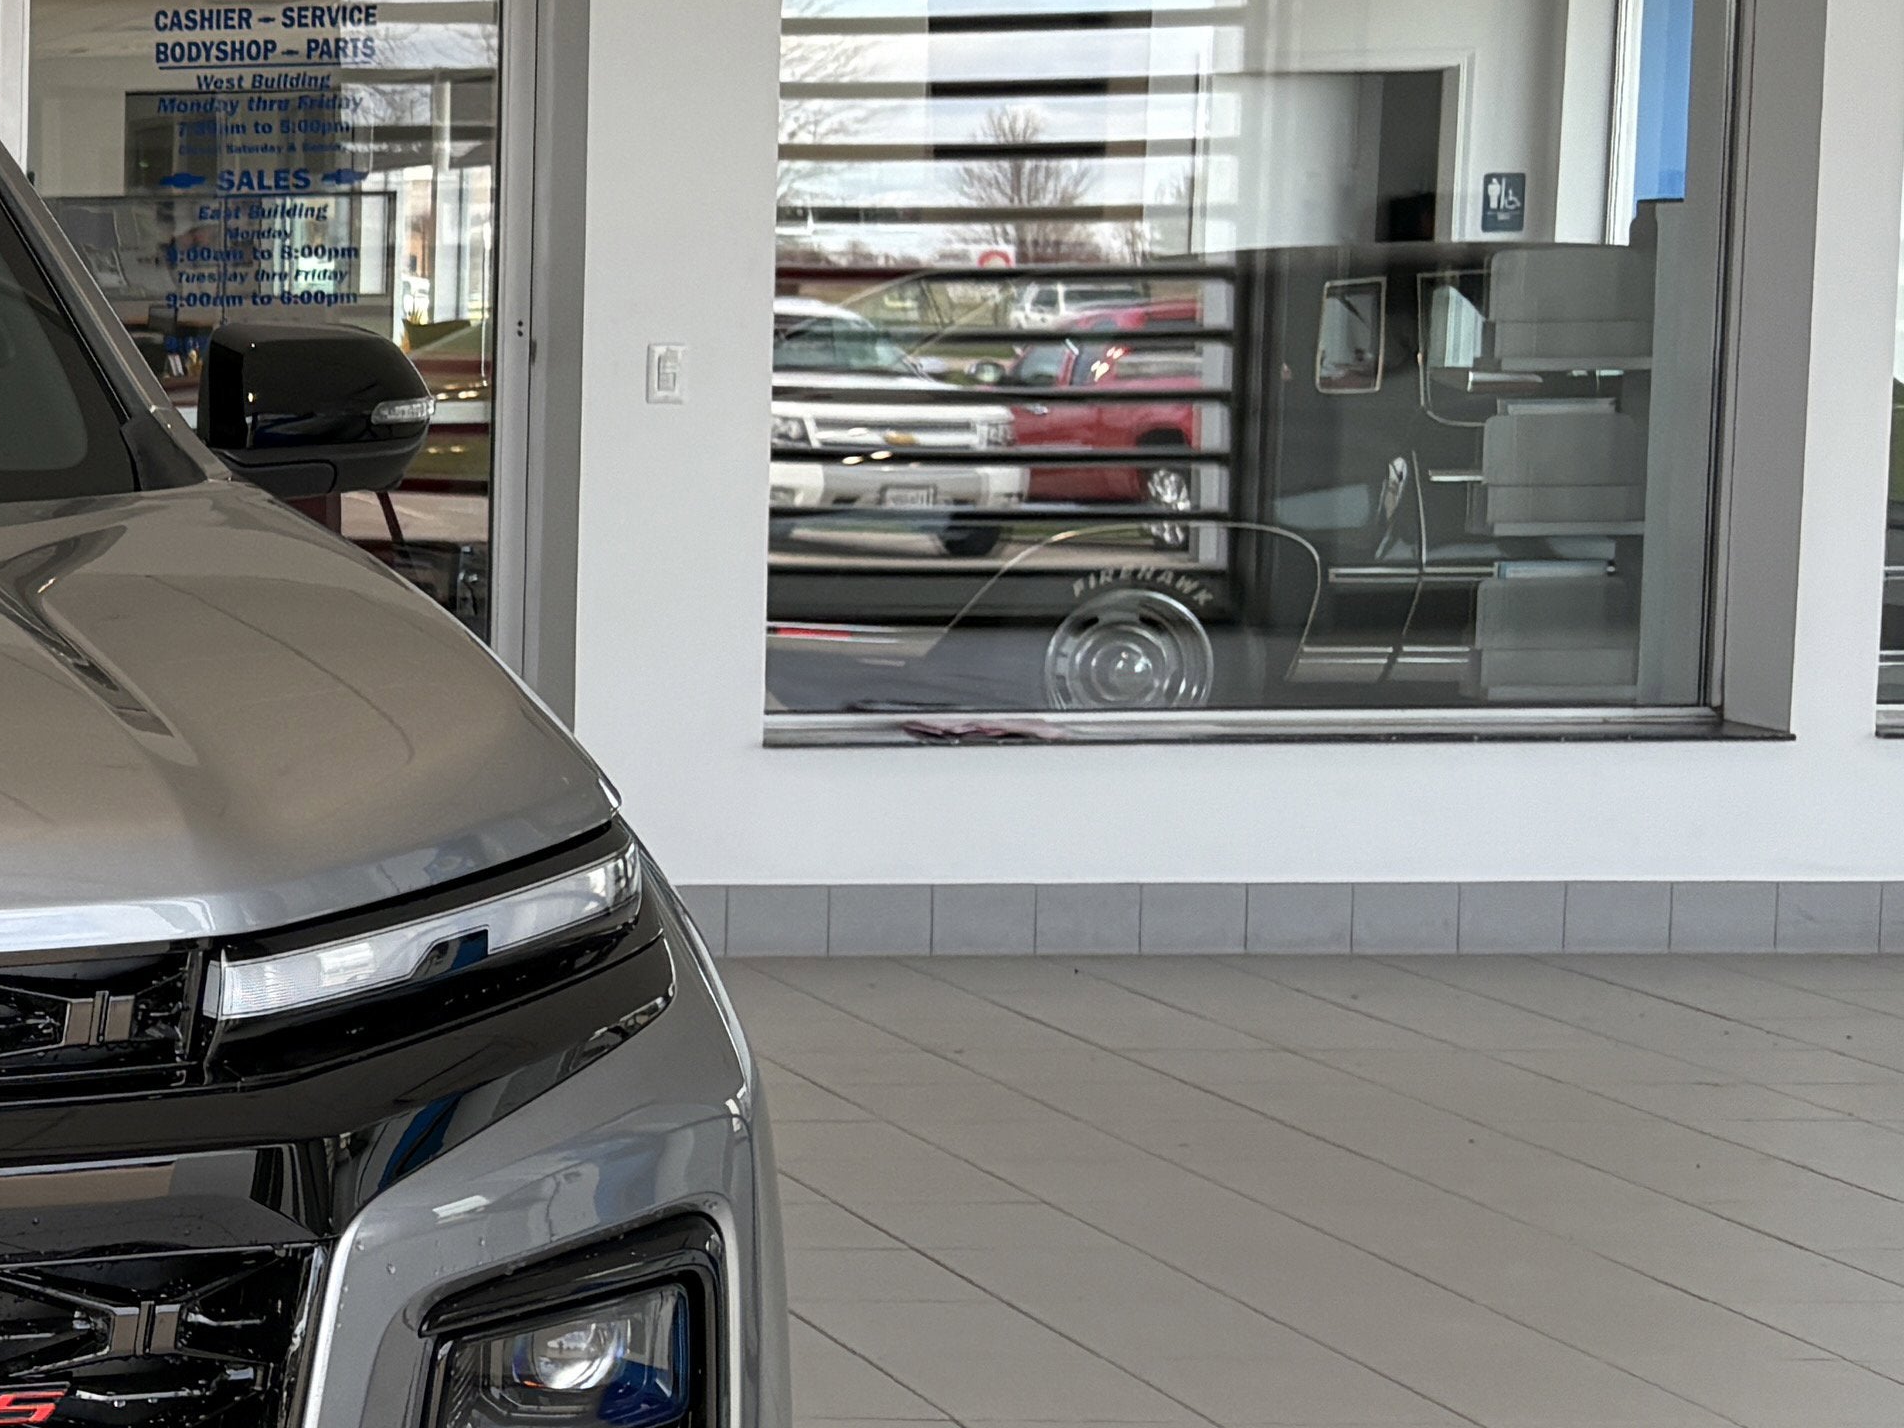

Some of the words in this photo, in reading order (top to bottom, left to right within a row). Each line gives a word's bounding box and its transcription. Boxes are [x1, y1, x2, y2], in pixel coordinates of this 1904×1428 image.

[154, 8, 252, 32] CASHIER
[281, 5, 378, 29] SERVICE
[155, 39, 277, 63] BODYSHOP
[306, 37, 375, 60] PARTS
[196, 74, 245, 90] West
[250, 72, 331, 92] Building
[157, 96, 239, 117] Monday
[247, 96, 290, 113] thru
[253, 120, 273, 135] to
[218, 169, 311, 191] SALES
[198, 205, 240, 220] East
[248, 203, 329, 221] Building
[227, 227, 292, 242] Monday
[252, 246, 272, 260] to
[165, 291, 243, 309] 9:00am
[251, 291, 272, 306] to
[1072, 564, 1214, 607] FIREHAWK
